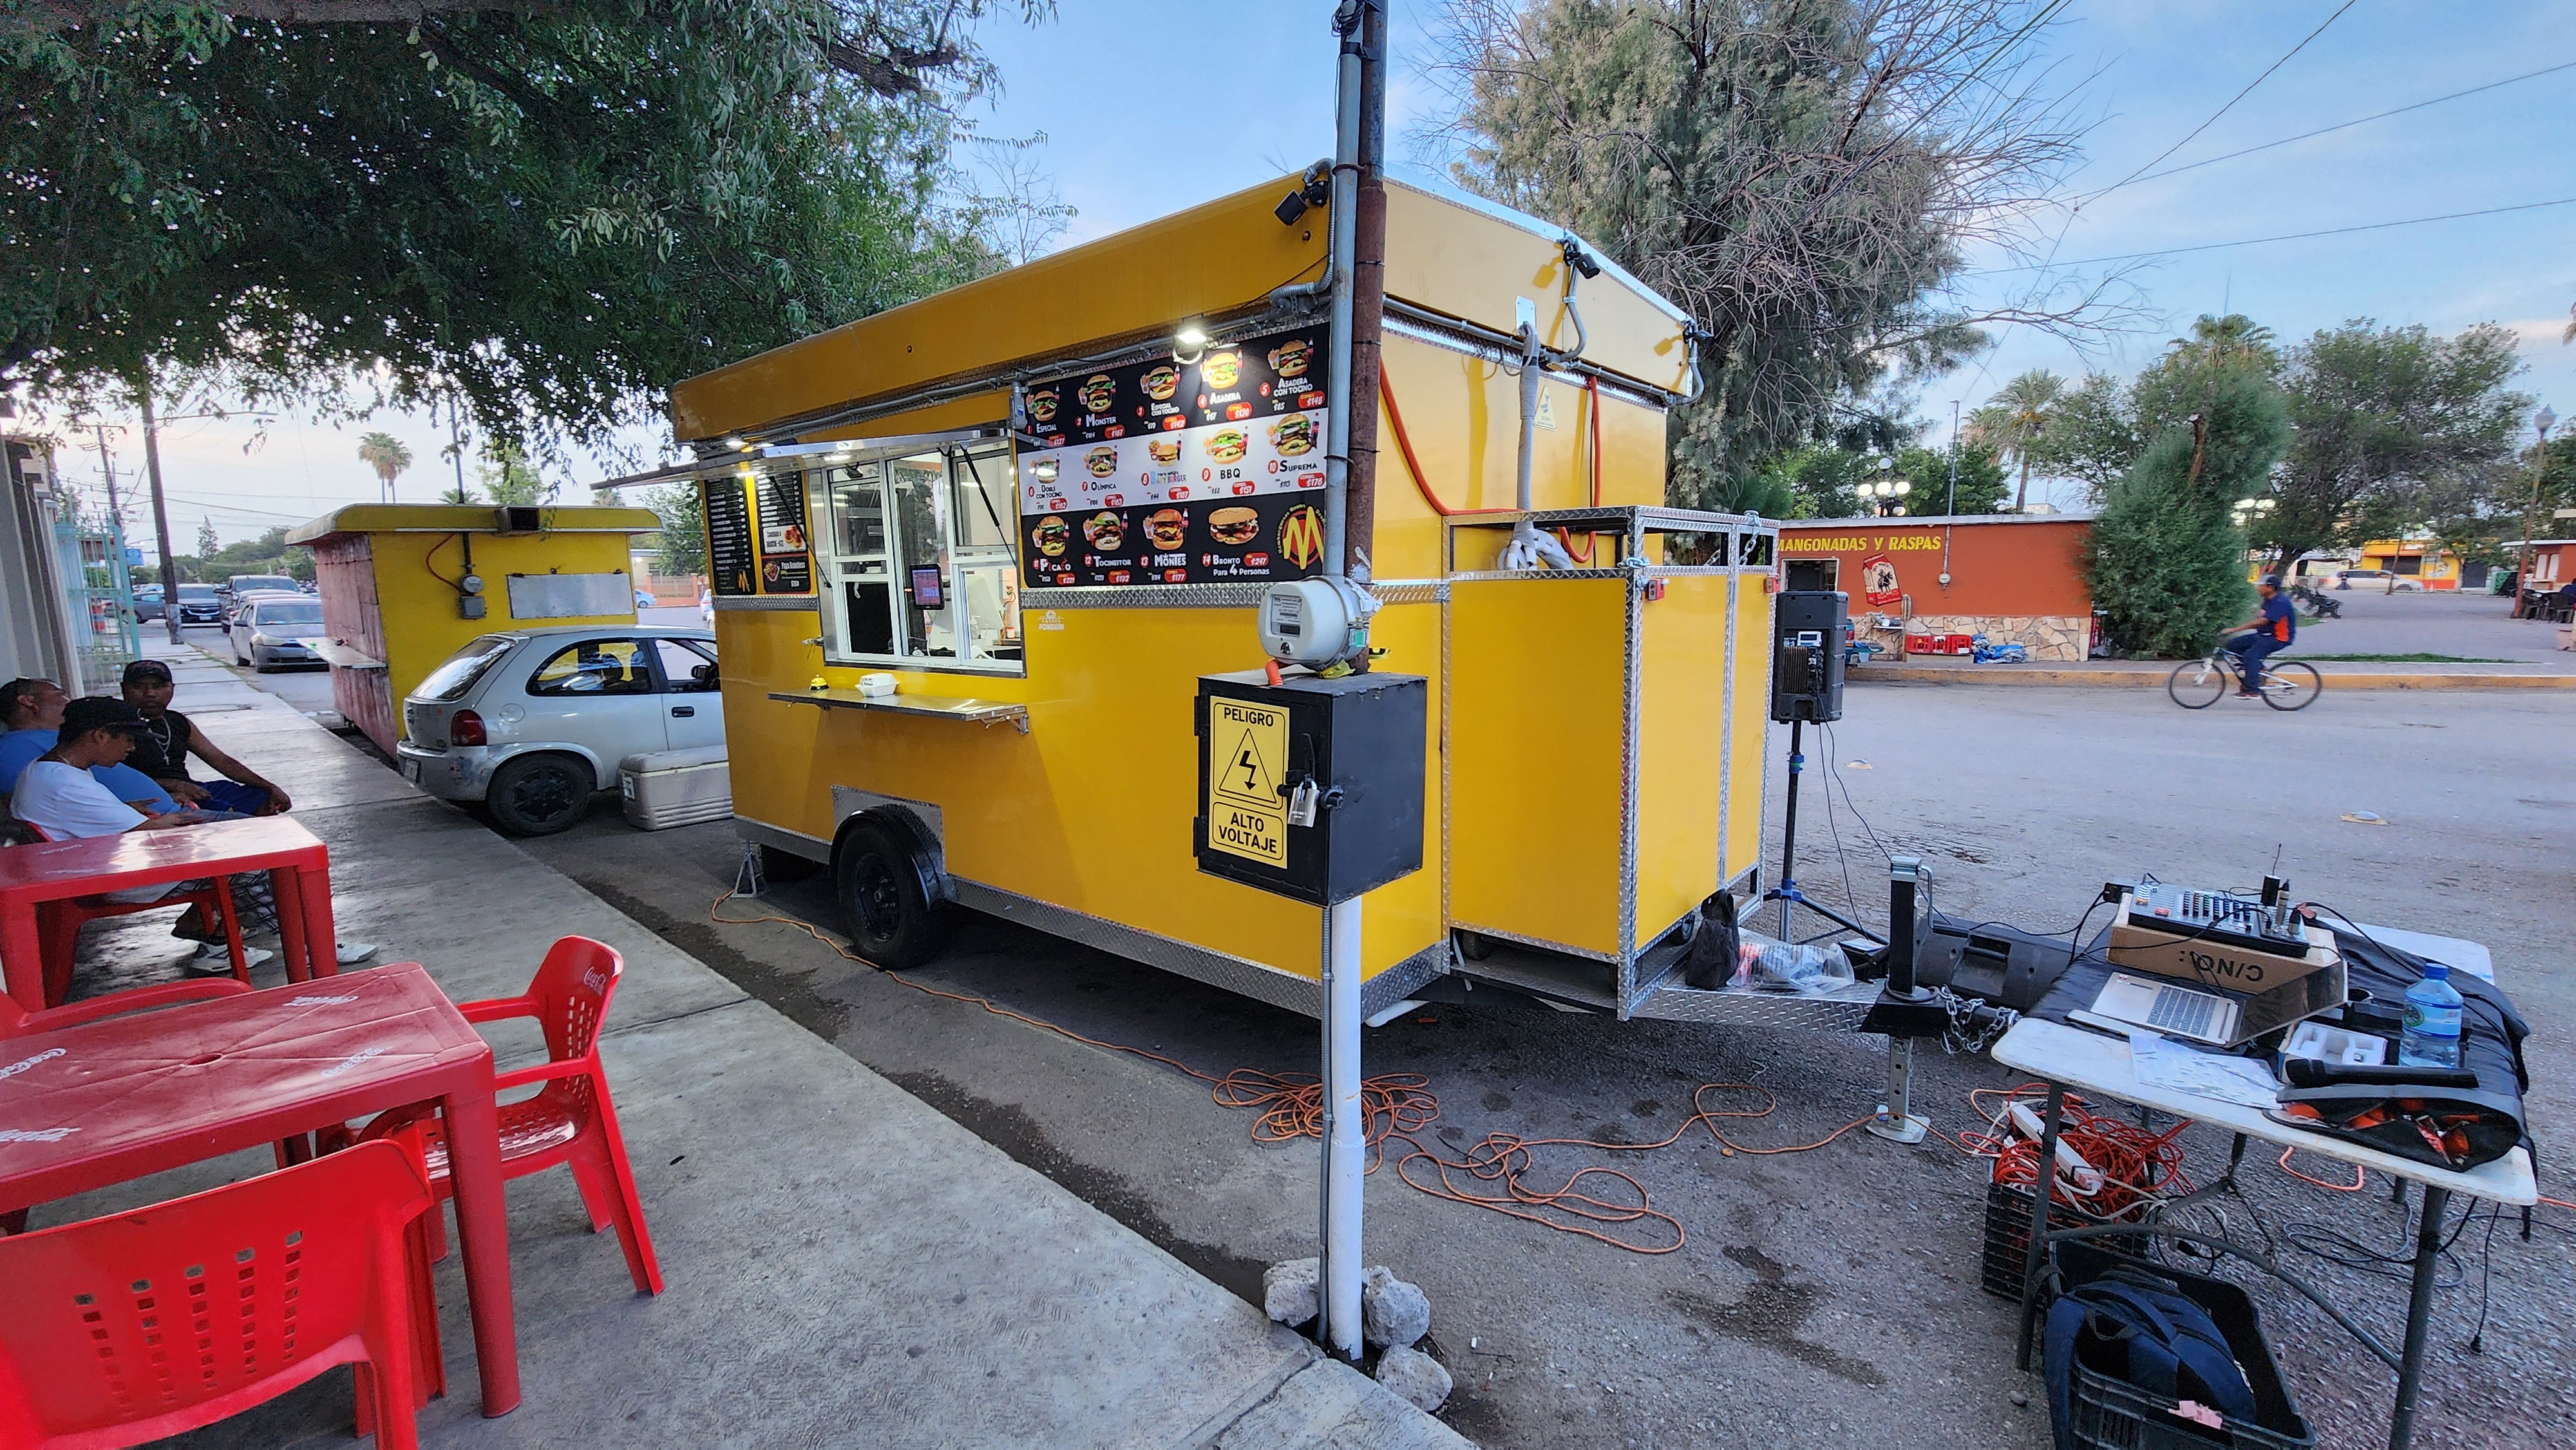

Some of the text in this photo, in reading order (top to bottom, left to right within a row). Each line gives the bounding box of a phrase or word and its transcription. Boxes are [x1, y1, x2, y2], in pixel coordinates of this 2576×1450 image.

[1273, 384, 1313, 397] CON TOCINO
[1307, 396, 1323, 406] $148
[1280, 460, 1318, 472] SUPREMA
[1220, 467, 1240, 480] BBQ
[1306, 478, 1323, 487] $176
[1889, 536, 1941, 550] RASPAS
[1229, 564, 1238, 576] 4
[1224, 706, 1274, 728] PELIGRO
[1231, 812, 1264, 833] ALTO
[1218, 825, 1277, 854] VOLTAJE
